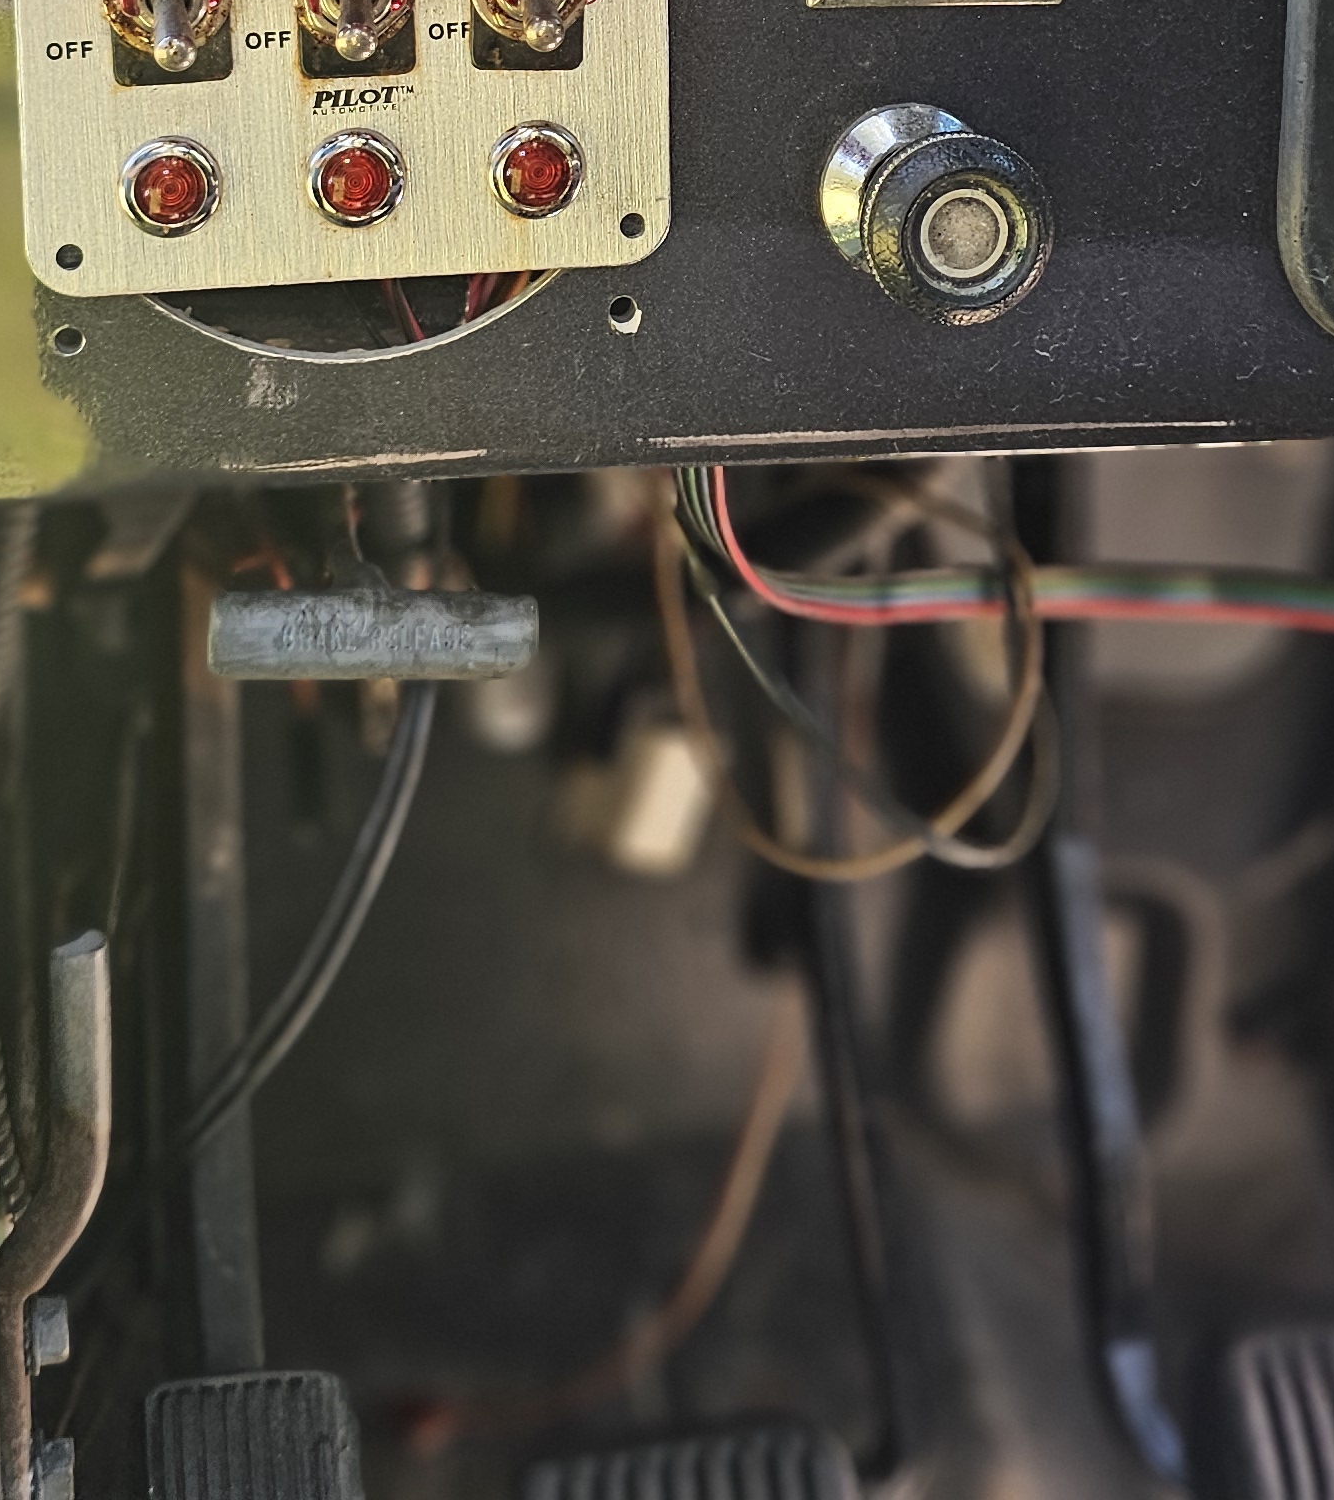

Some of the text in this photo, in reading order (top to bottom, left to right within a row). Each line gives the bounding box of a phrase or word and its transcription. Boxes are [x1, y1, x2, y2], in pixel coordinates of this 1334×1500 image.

[245, 30, 292, 50] OFF
[428, 21, 471, 41] OFF
[46, 40, 94, 61] OFF
